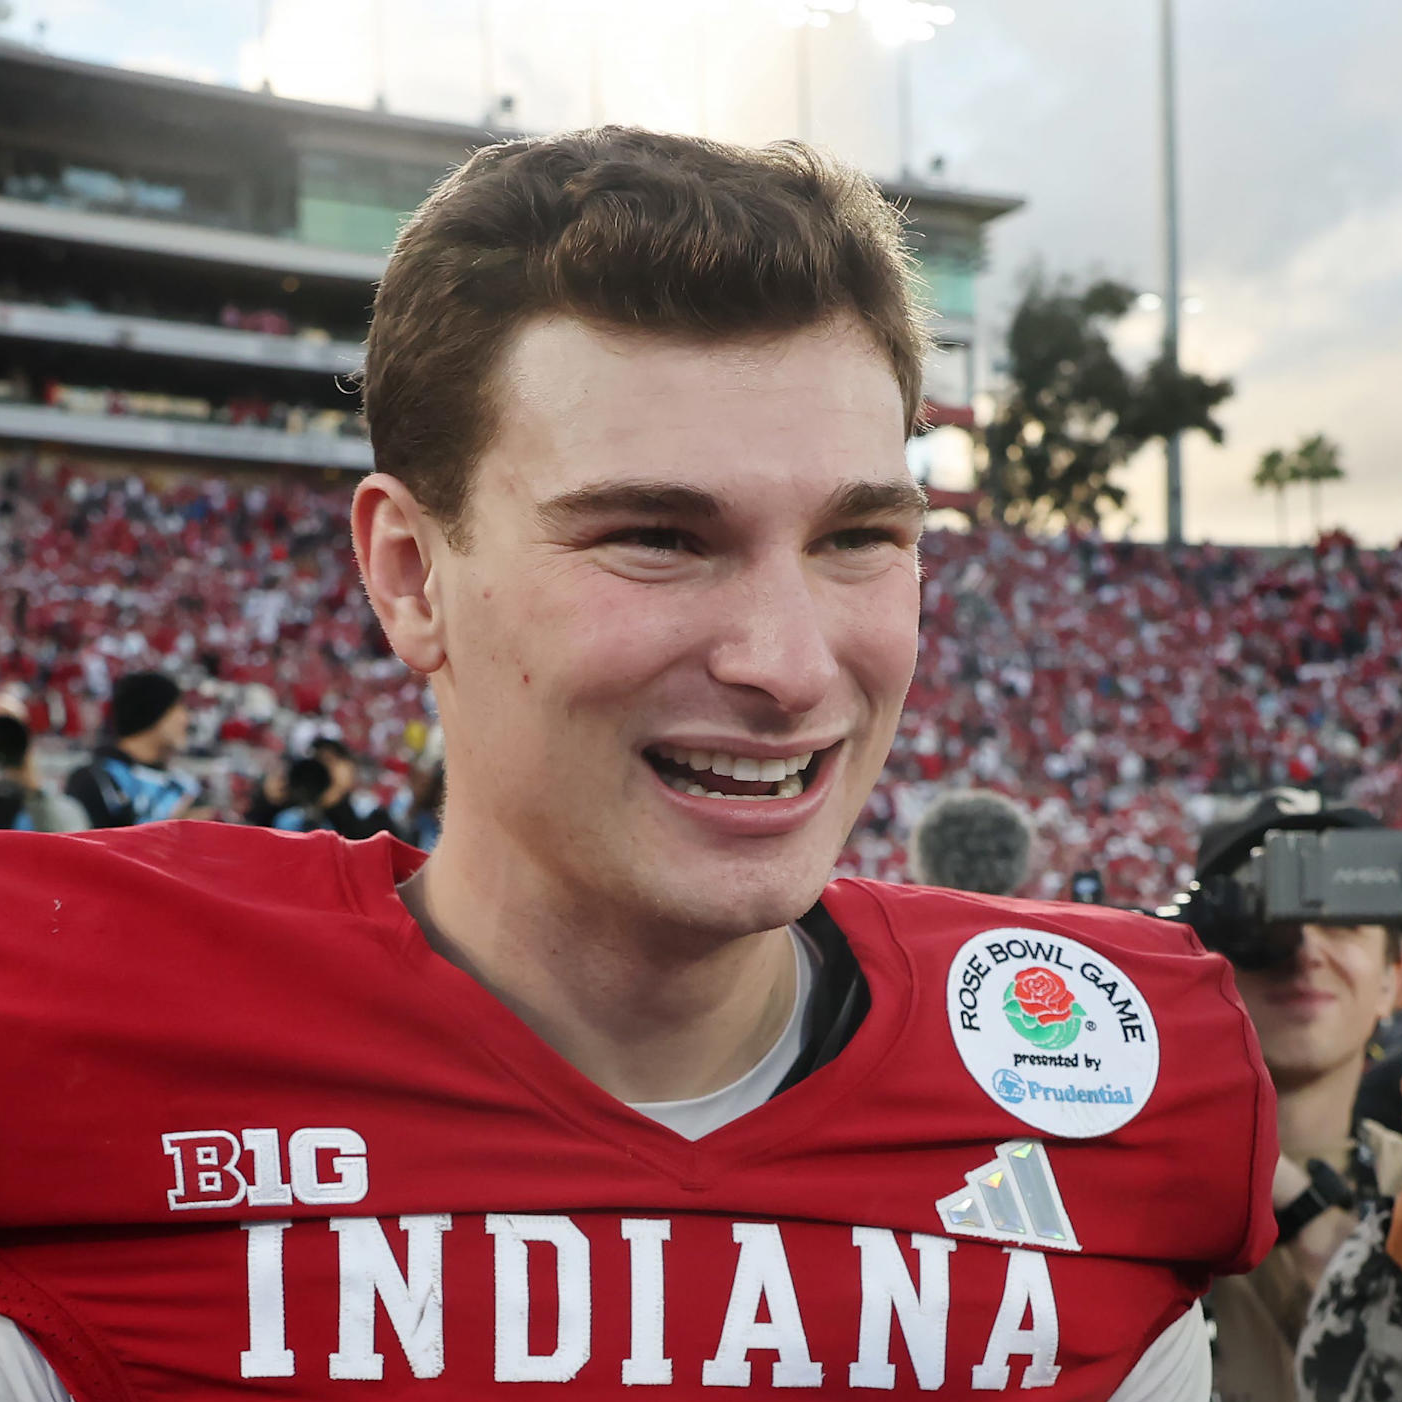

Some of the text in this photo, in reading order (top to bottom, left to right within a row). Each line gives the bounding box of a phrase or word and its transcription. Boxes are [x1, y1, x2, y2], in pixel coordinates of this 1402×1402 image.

[959, 939, 1146, 1043] ROSE BOWL GAME
[1014, 1053, 1102, 1072] presented by
[1026, 1080, 1135, 1105] Prudential
[238, 1213, 1064, 1392] INDIANA
